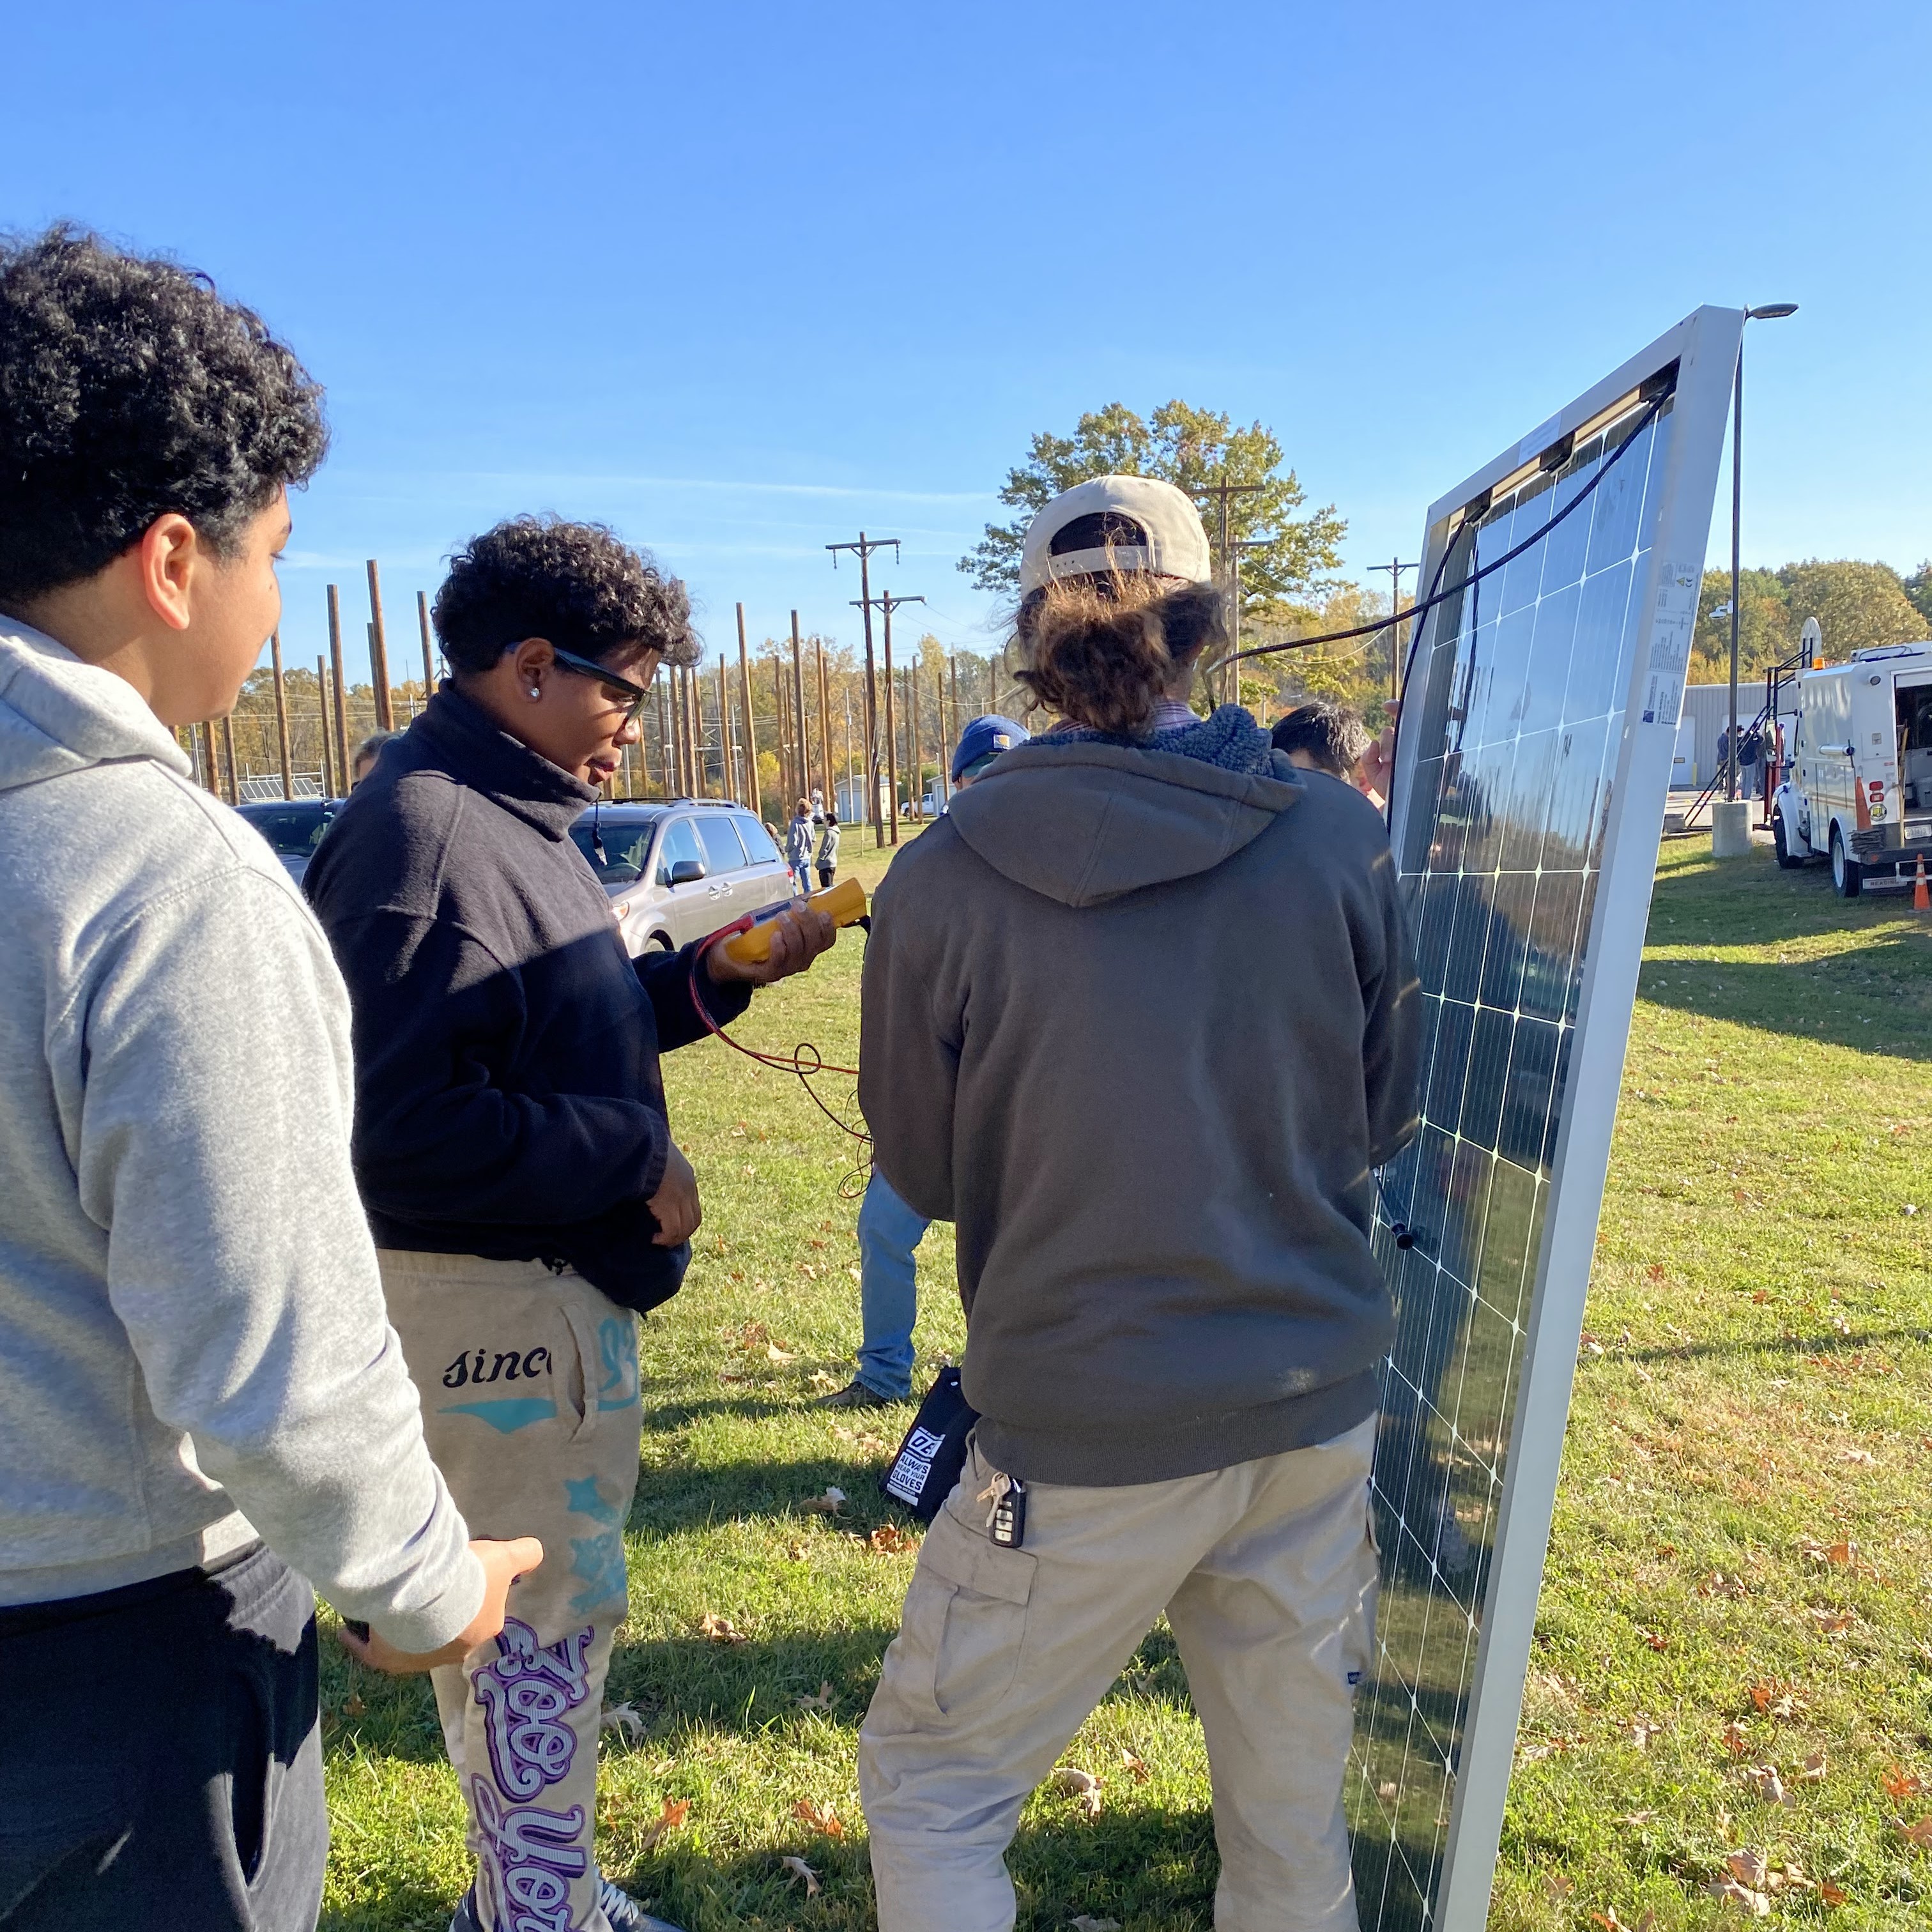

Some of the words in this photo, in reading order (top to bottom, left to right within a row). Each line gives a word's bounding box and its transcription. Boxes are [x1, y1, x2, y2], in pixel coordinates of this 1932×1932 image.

[443, 1347, 552, 1388] sinc
[911, 1436, 936, 1455] OE
[897, 1463, 911, 1474] WEAR
[892, 1469, 923, 1491] GLOVES
[471, 1773, 586, 1932] Yor
